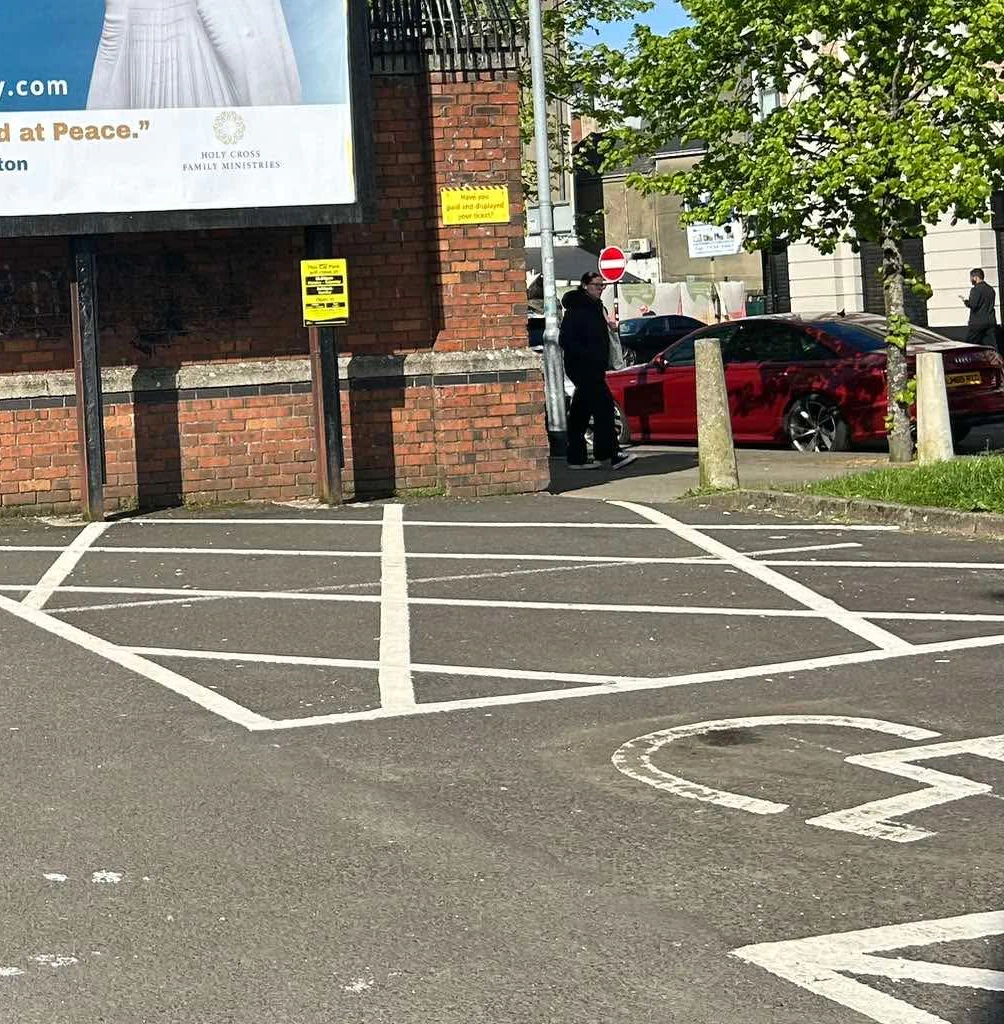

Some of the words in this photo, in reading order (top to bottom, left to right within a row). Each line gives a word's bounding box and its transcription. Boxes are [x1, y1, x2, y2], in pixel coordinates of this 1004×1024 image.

[19, 123, 45, 143] at
[53, 120, 150, 141] Peace.”
[201, 150, 227, 160] HOLY
[230, 150, 261, 158] CROSS
[182, 162, 218, 172] FAMILY
[222, 161, 281, 170] MINISTRIES
